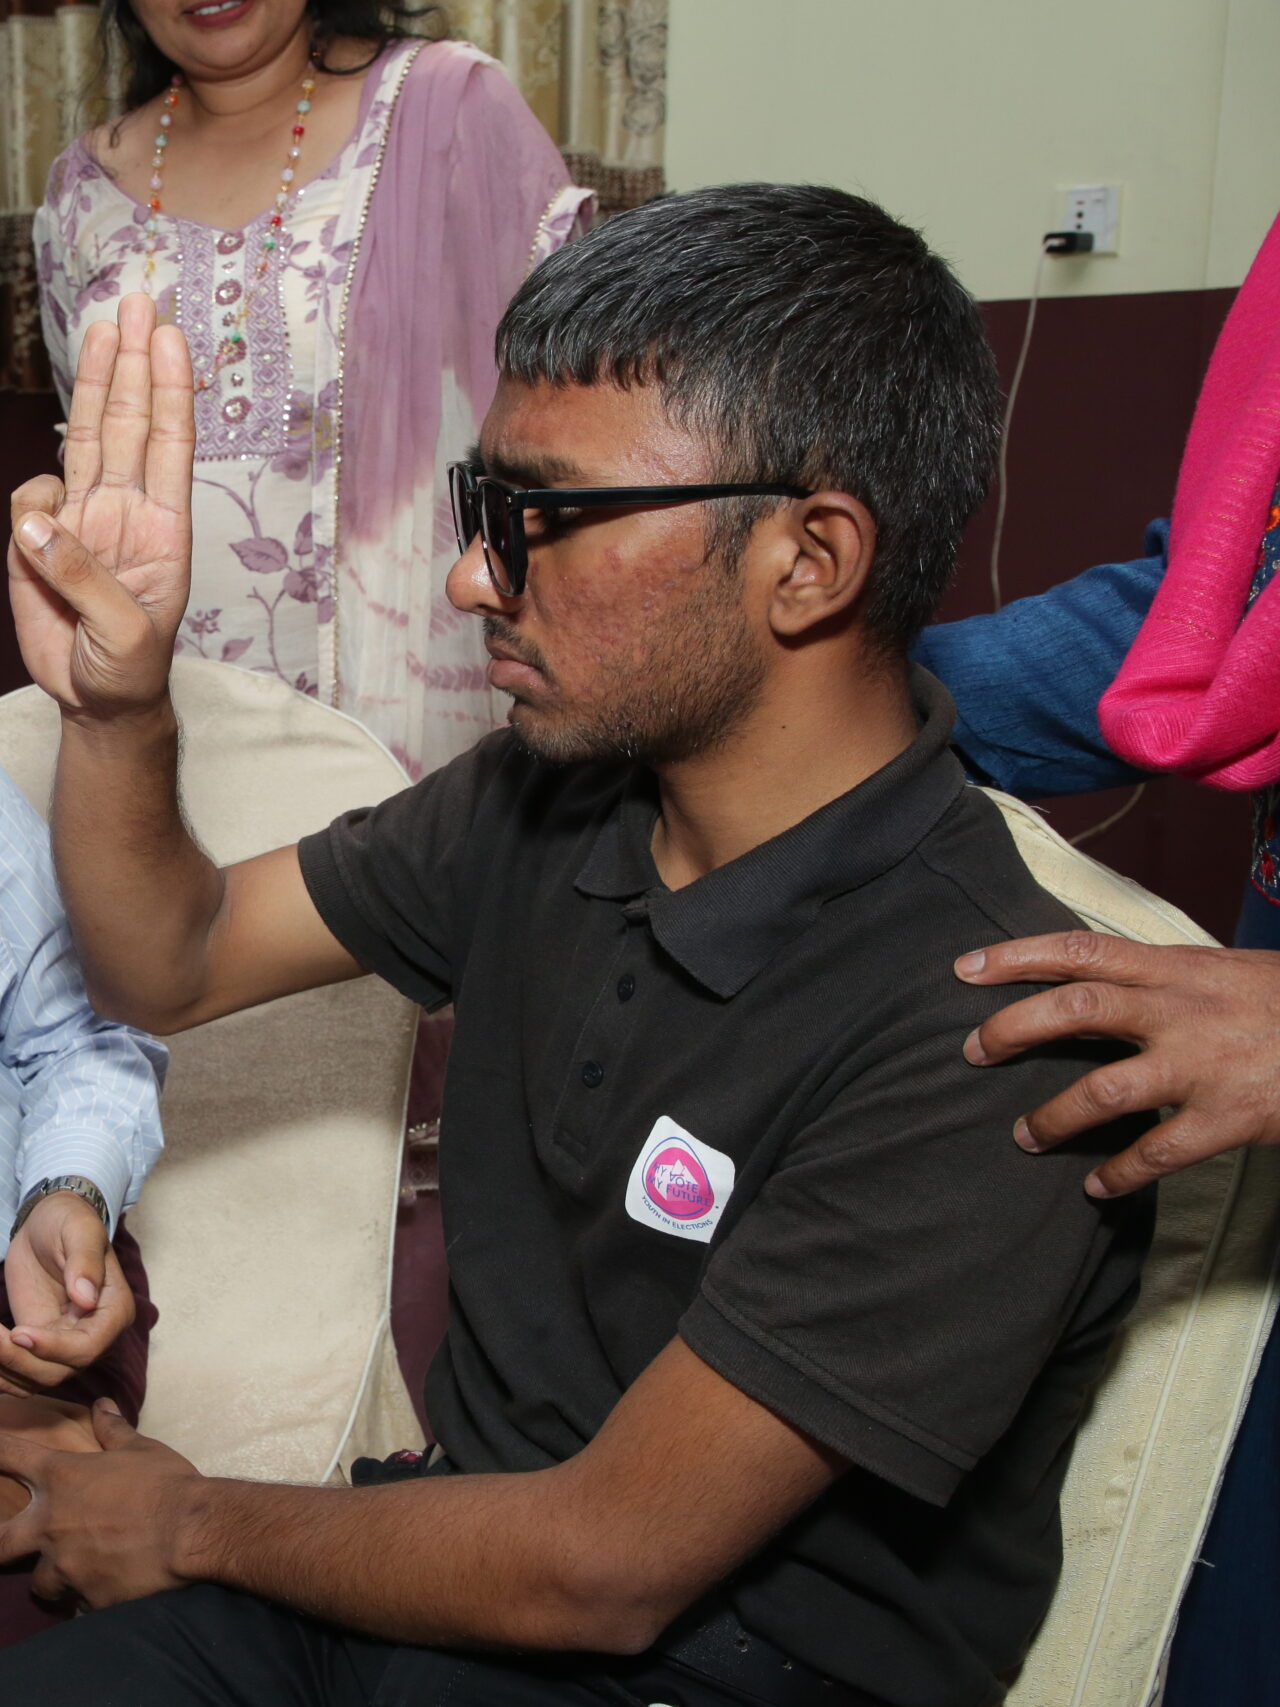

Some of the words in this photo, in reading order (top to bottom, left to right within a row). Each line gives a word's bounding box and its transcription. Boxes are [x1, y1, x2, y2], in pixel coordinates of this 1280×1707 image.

[647, 1175, 663, 1189] MY
[666, 1184, 710, 1206] FUTURE
[653, 1162, 667, 1175] MY
[669, 1171, 699, 1193] VOTE
[642, 1195, 661, 1219] YOUTH
[662, 1217, 670, 1225] IN
[672, 1219, 714, 1230] ELECTIONS
